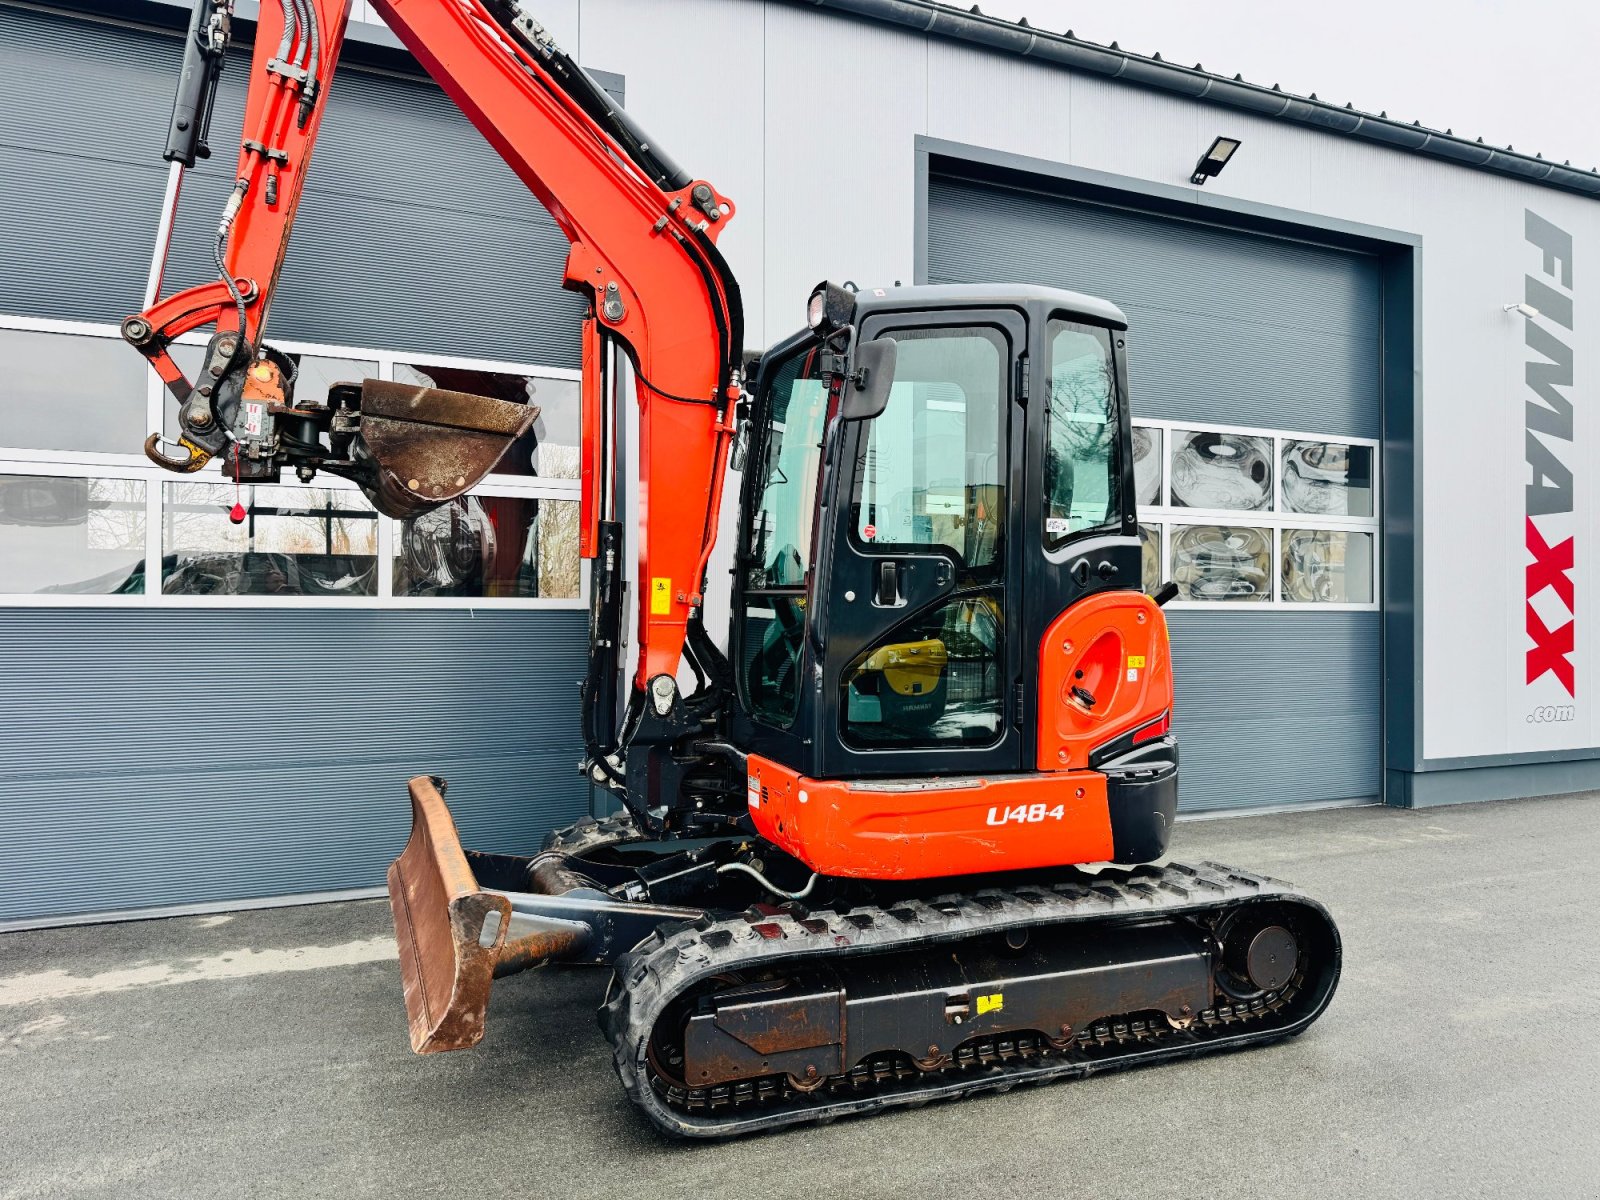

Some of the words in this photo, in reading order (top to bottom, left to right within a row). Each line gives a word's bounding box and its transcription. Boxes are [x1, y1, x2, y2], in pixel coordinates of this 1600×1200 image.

[1525, 208, 1575, 699] FIMAXX
[1526, 705, 1575, 723] .com
[986, 803, 1065, 826] U48-4
